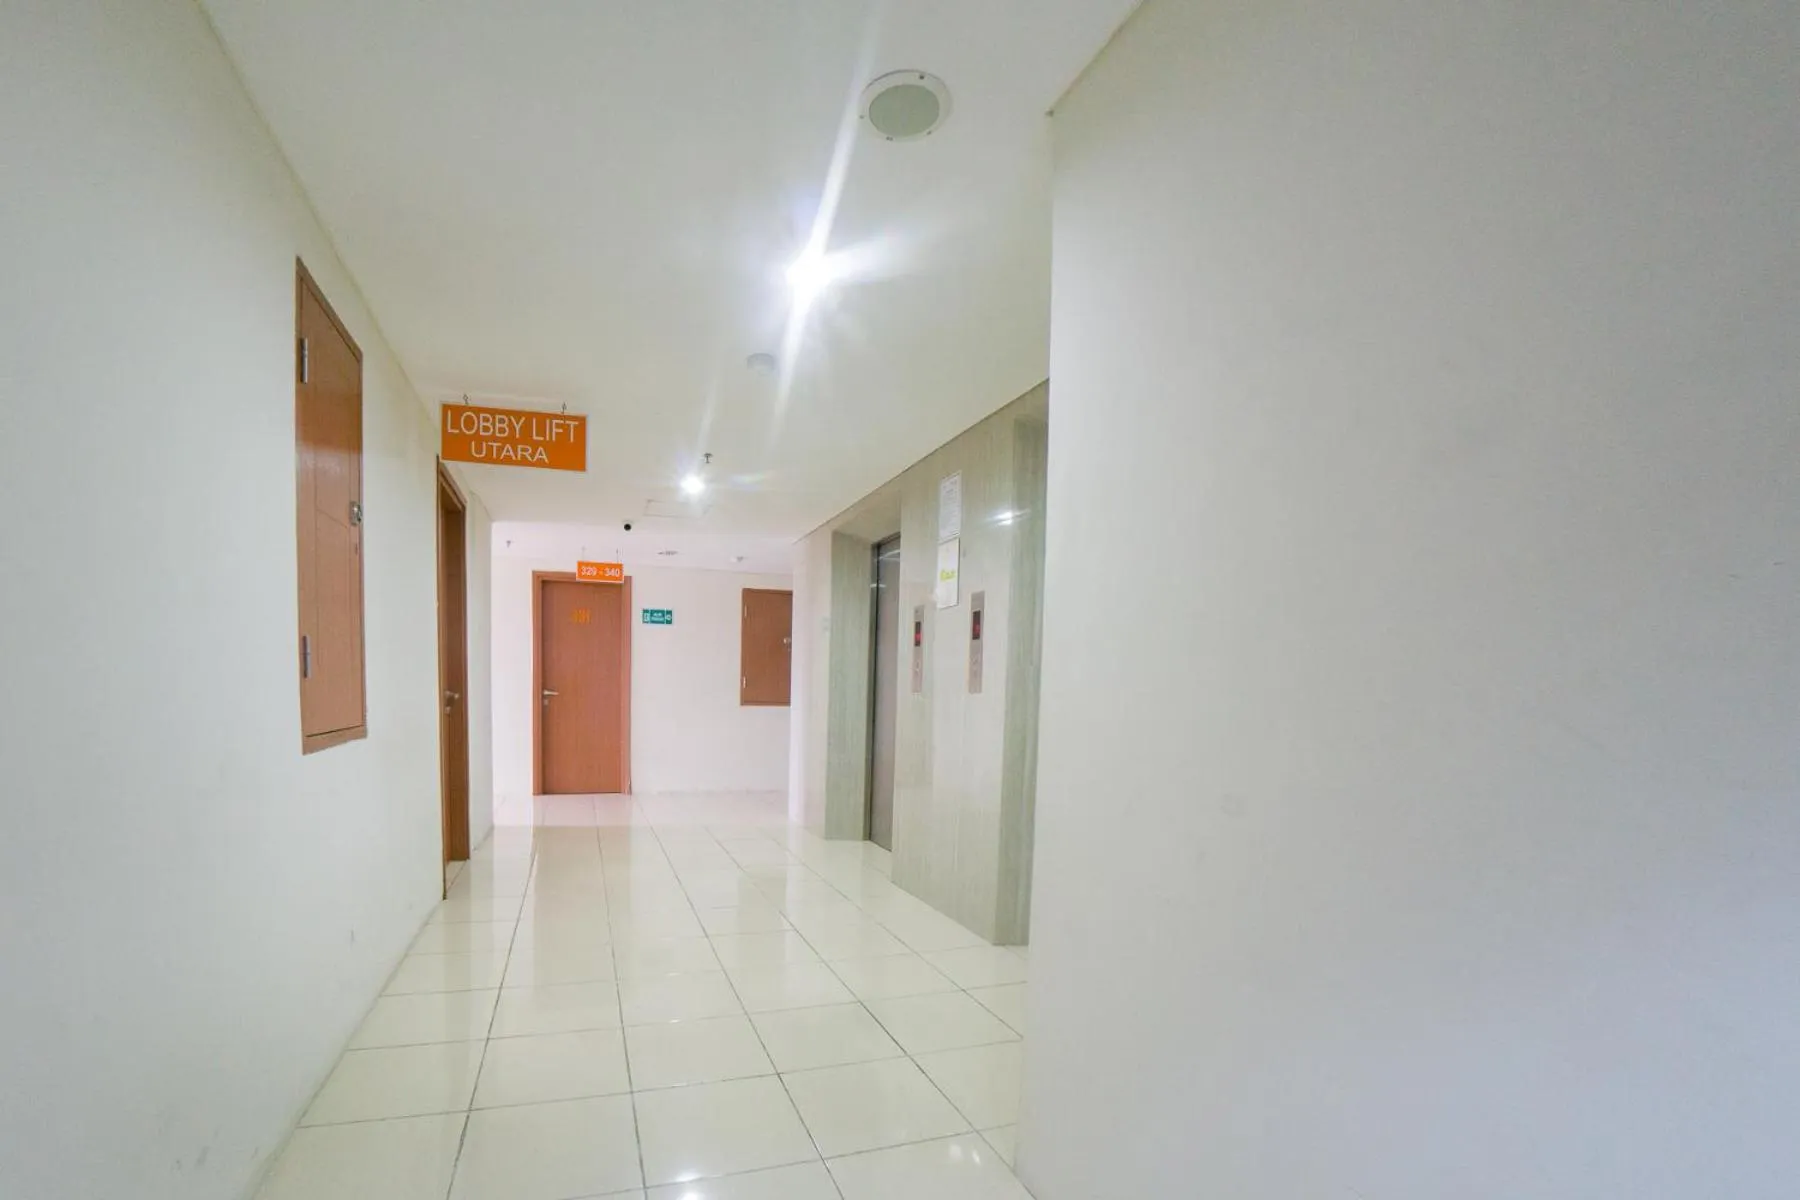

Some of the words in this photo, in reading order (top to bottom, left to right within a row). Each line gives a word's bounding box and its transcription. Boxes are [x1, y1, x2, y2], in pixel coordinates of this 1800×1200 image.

[447, 410, 525, 438] LOBBY
[532, 417, 579, 443] LIFT
[471, 441, 549, 463] UTARA
[604, 567, 620, 577] 340
